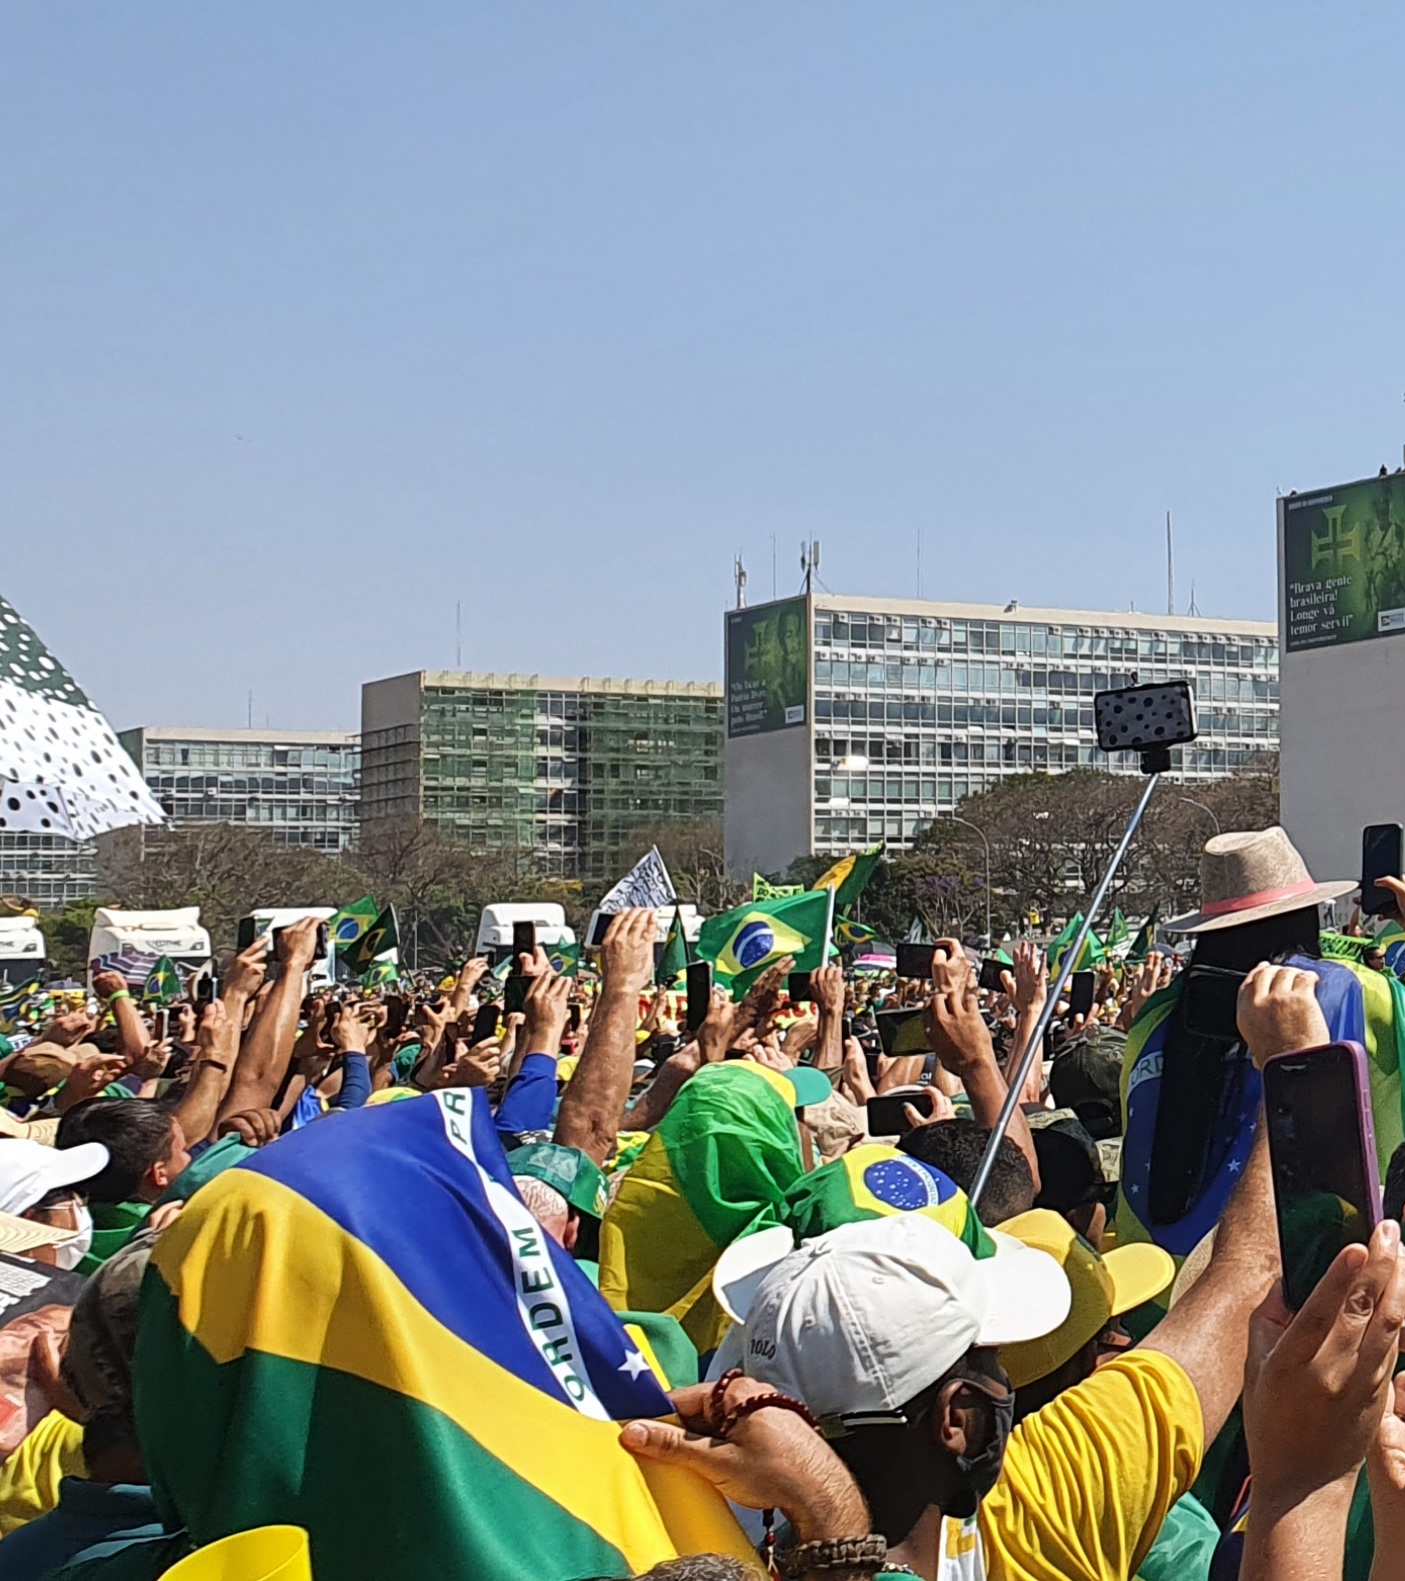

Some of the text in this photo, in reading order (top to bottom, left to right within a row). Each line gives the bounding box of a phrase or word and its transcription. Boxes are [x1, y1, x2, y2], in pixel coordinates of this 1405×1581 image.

[1325, 575, 1353, 589] gente
[1290, 591, 1338, 608] brasileira!
[1290, 608, 1320, 622] Longe
